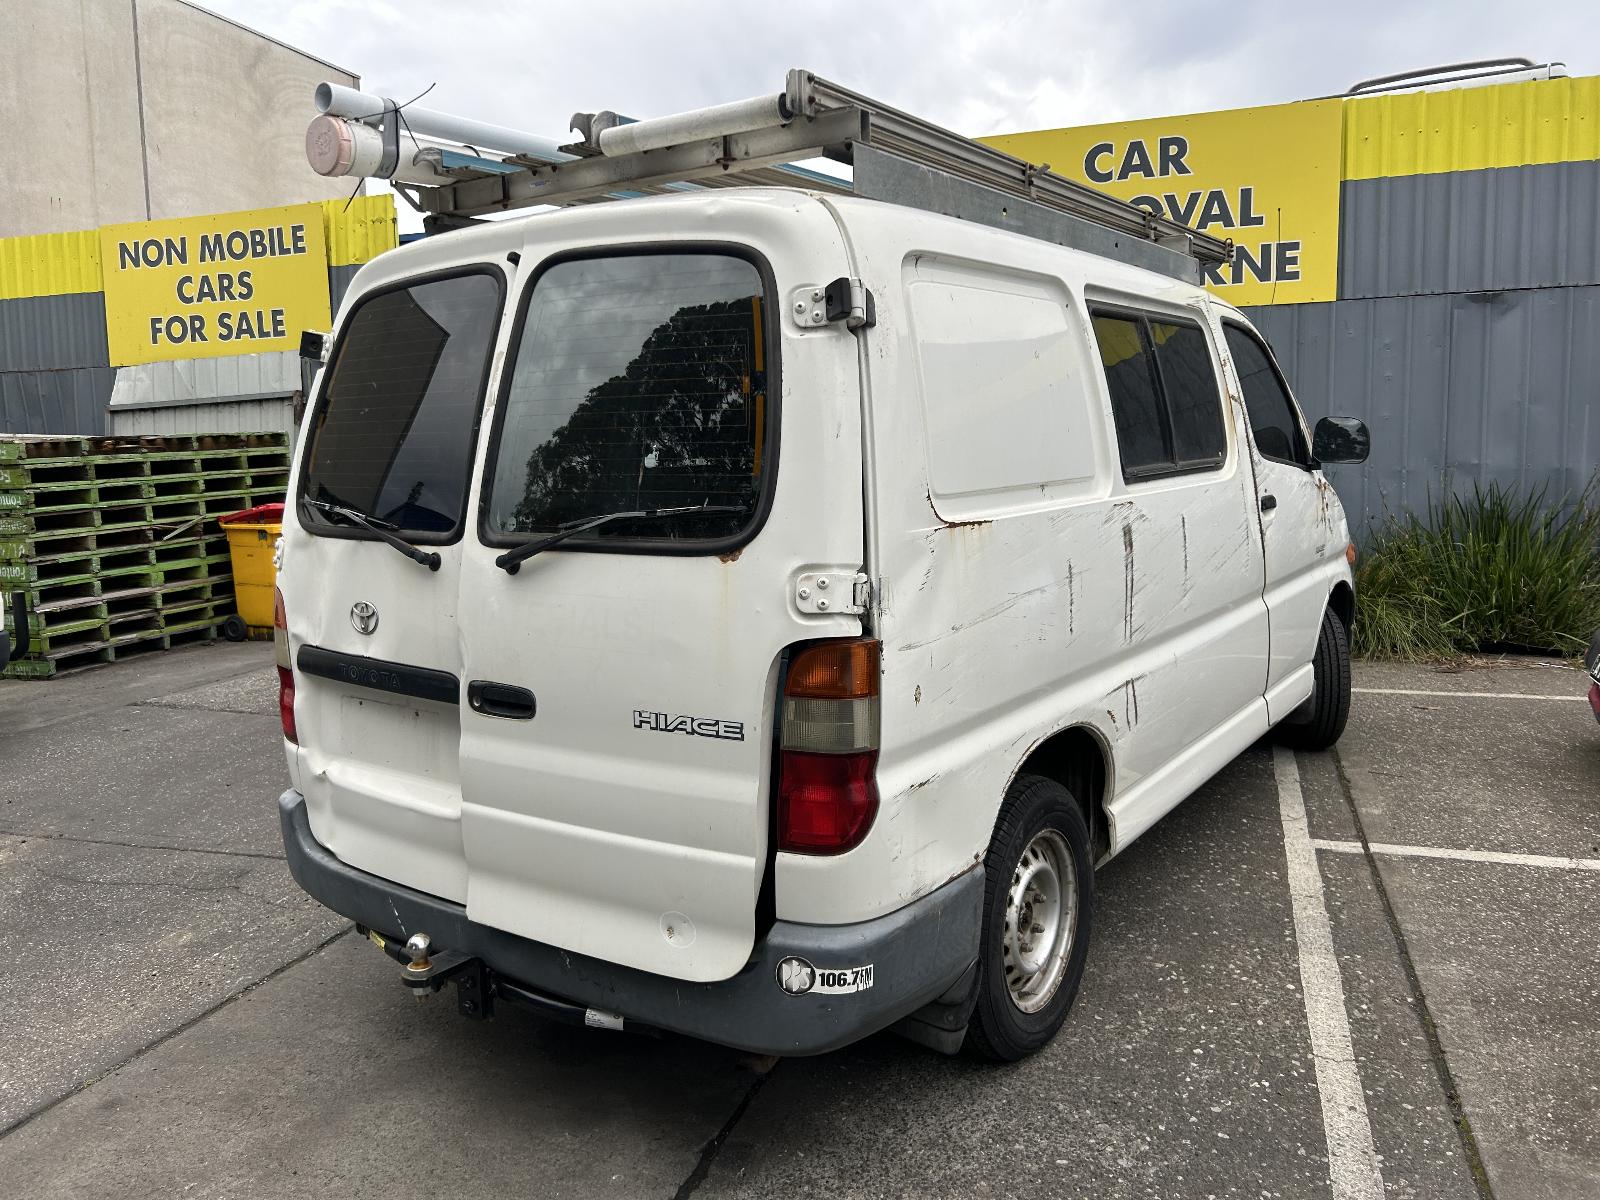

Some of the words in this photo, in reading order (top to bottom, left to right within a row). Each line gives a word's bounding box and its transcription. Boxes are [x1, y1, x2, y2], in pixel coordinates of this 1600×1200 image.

[1083, 136, 1192, 184] CAR
[119, 236, 188, 270] NON
[200, 224, 306, 263] MOBILE
[176, 271, 254, 305] CARS
[150, 314, 208, 345] FOR
[217, 308, 286, 342] SALE
[337, 662, 400, 689] TOYOTA
[633, 710, 744, 741] HIACE
